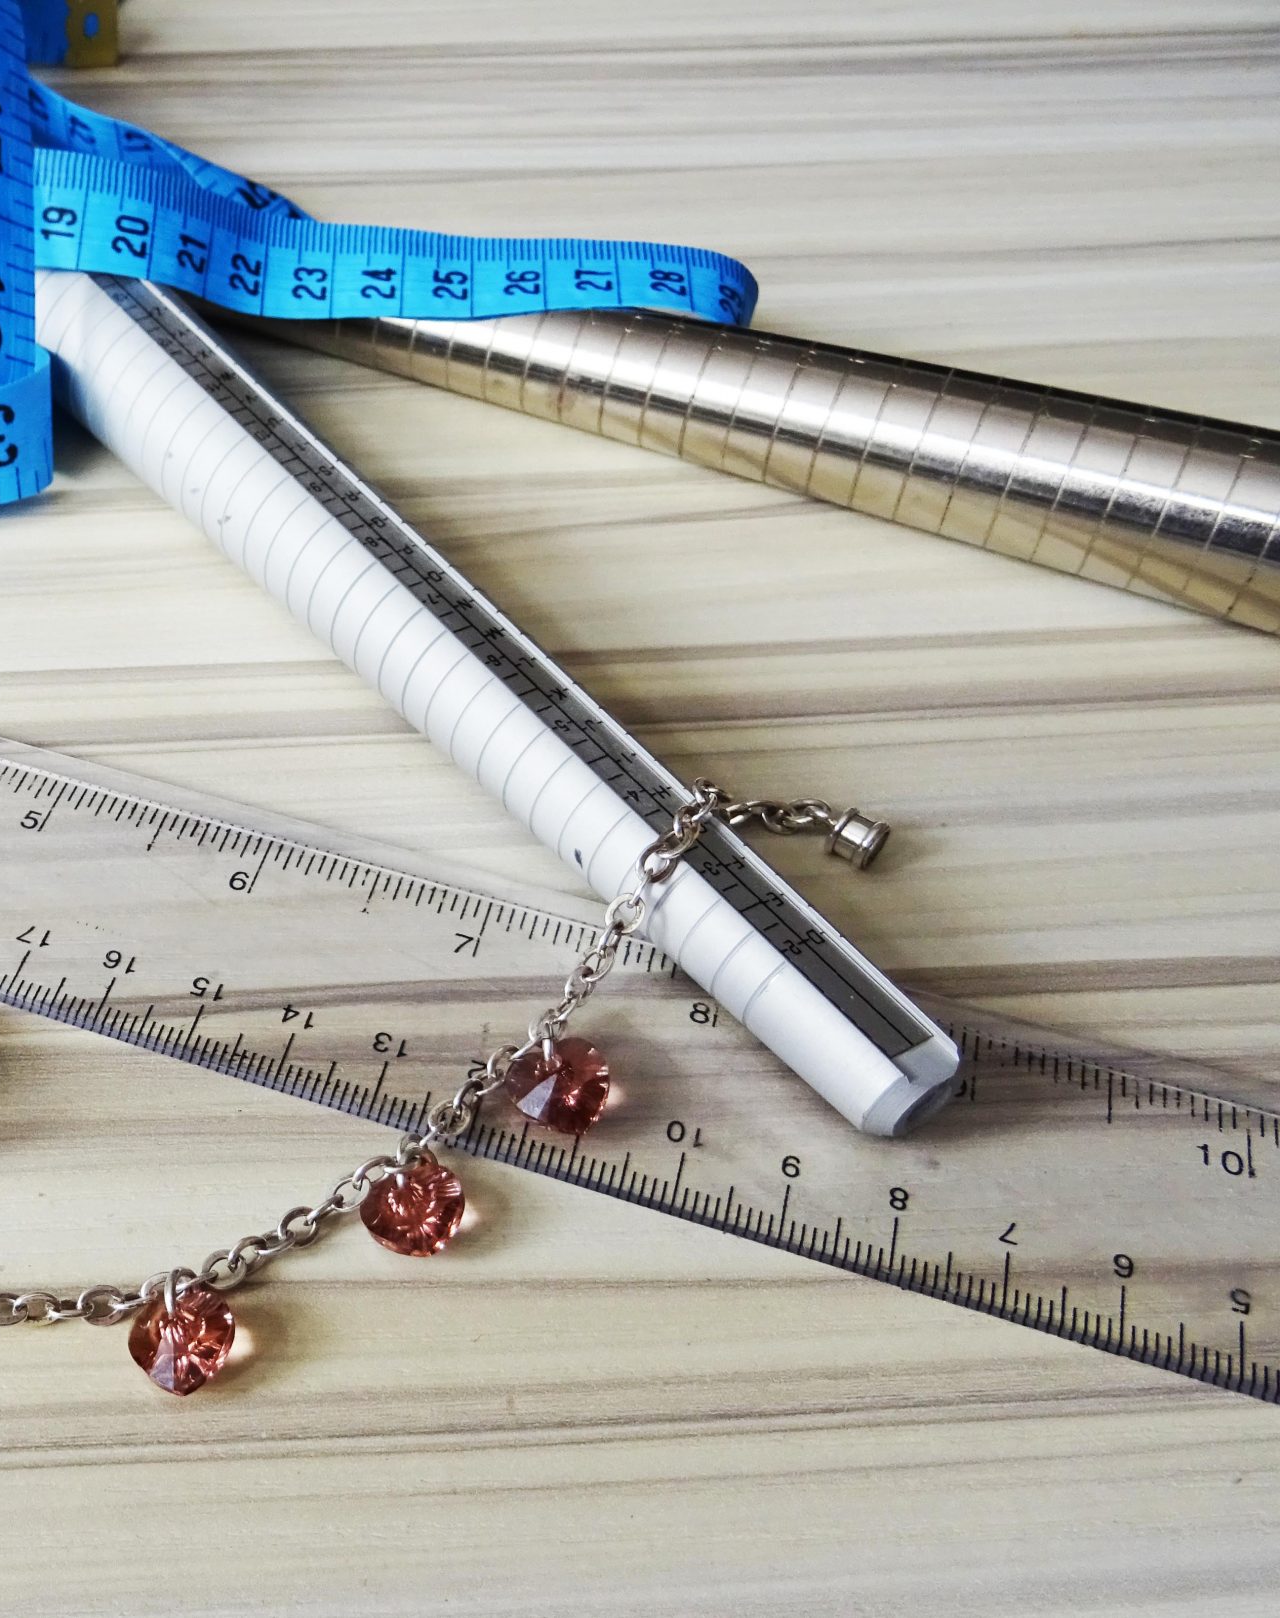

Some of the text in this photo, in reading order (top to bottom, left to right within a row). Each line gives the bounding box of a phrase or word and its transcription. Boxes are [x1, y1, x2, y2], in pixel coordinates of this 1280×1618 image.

[40, 206, 79, 242] 19
[111, 214, 150, 260] 20
[177, 233, 208, 275] 21
[230, 252, 263, 297] 22
[292, 266, 329, 302] 23
[361, 267, 397, 301] 24
[431, 268, 469, 302] 25
[503, 269, 541, 298] 26
[575, 268, 613, 293] 27
[650, 268, 687, 298] 28
[456, 599, 473, 611] N
[549, 687, 568, 700] K
[653, 785, 671, 799] H
[766, 891, 785, 907] E
[806, 929, 826, 945] D
[554, 719, 570, 733] 5
[703, 861, 721, 876] 3
[783, 939, 802, 956] 2
[16, 926, 51, 948] 17
[102, 950, 137, 975] 16
[190, 976, 224, 1002] 15
[281, 1004, 315, 1030] 14
[372, 1032, 409, 1059] 13
[666, 1120, 704, 1149] 10
[780, 1155, 802, 1179] 9
[888, 1187, 910, 1212] 8
[998, 1222, 1019, 1247] 7
[1113, 1254, 1134, 1279] 6
[1230, 1288, 1252, 1315] 5
[20, 810, 42, 830] 5
[229, 871, 249, 890] 6
[454, 933, 474, 953] 7
[690, 1002, 710, 1024] 8
[1196, 1143, 1243, 1176] 10
